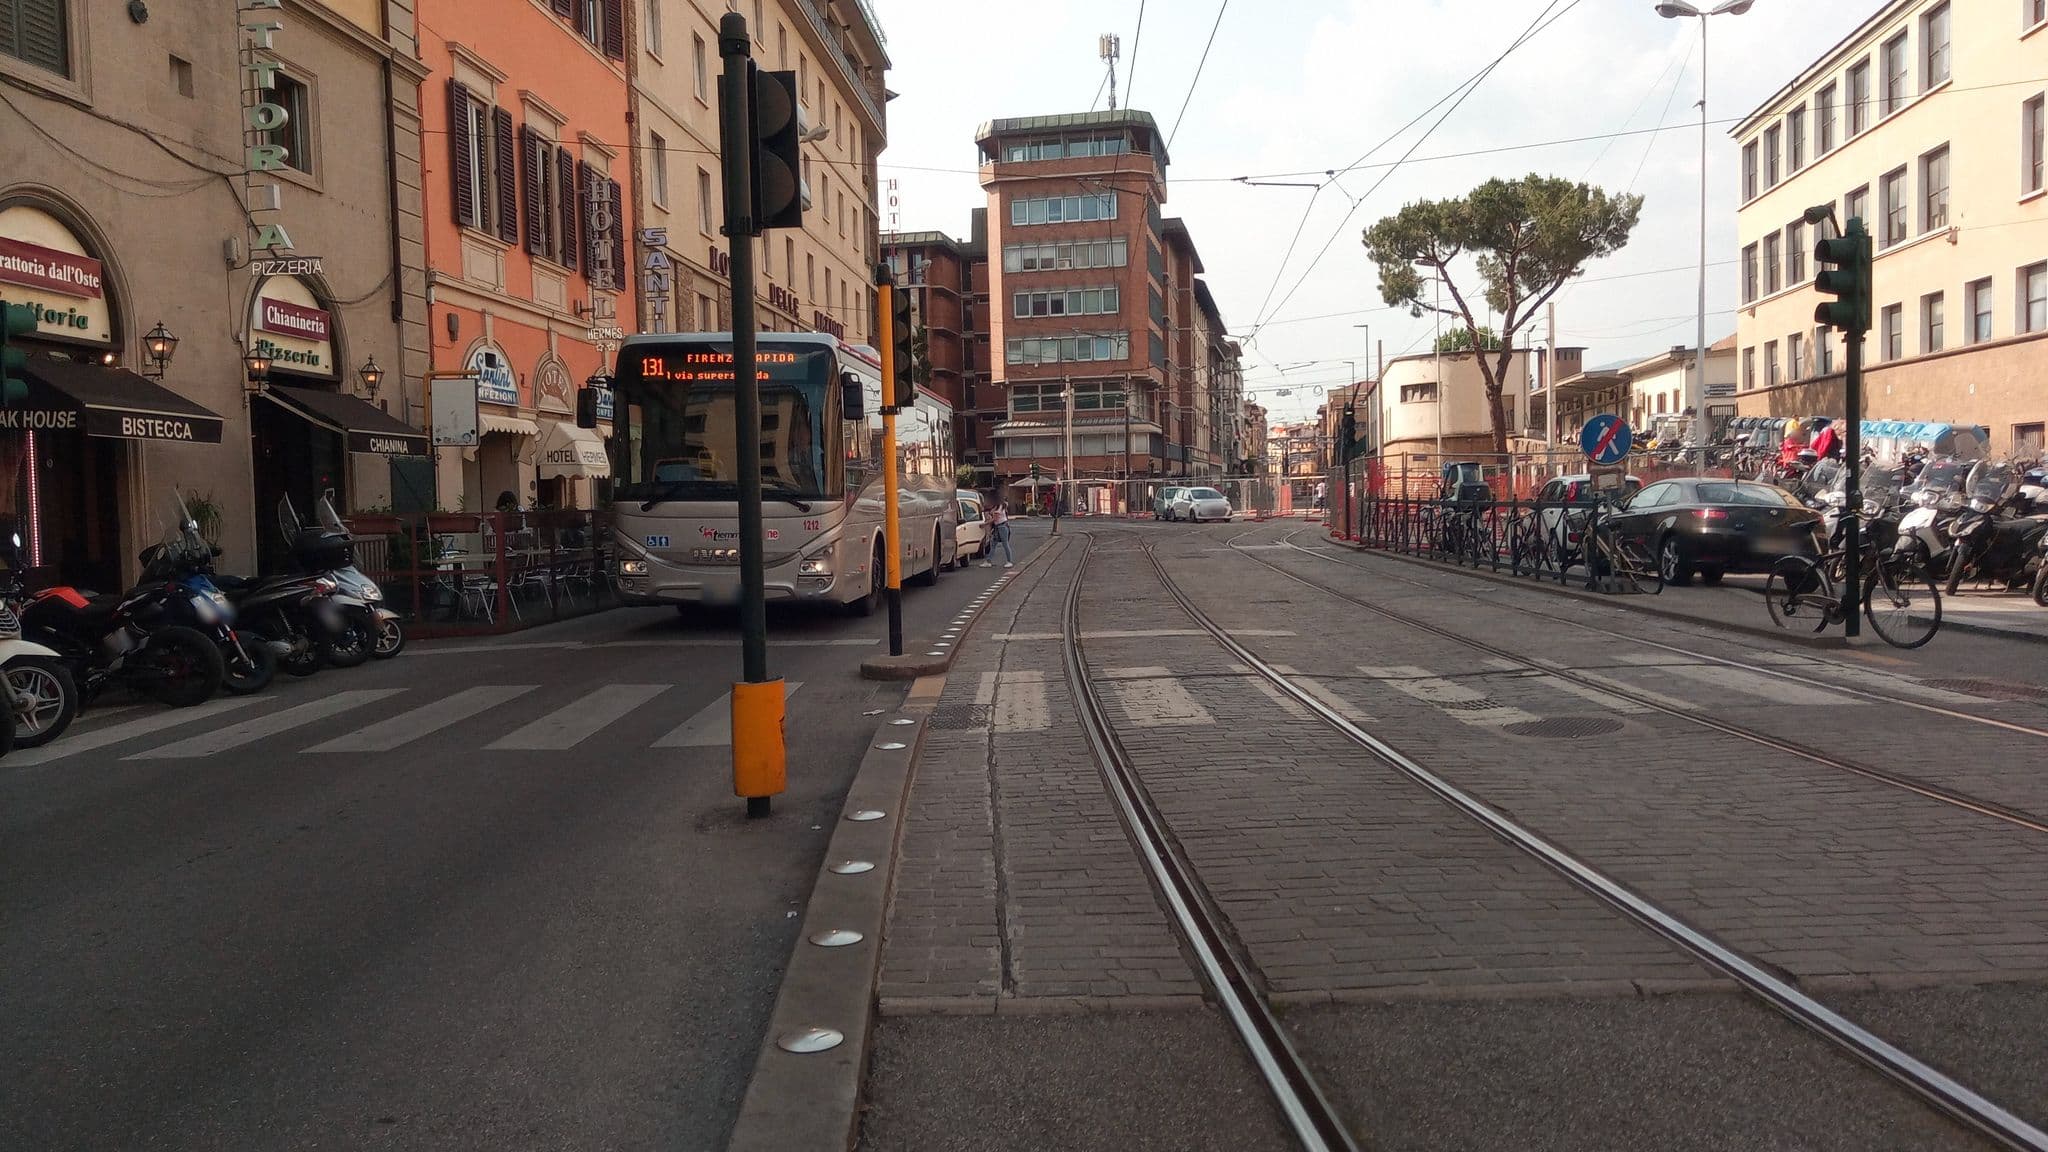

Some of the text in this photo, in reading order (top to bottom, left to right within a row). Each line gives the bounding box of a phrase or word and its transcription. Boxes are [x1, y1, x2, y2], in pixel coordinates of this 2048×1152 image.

[591, 179, 616, 320] HOTEL
[48, 262, 100, 288] dall'Oste
[252, 259, 324, 276] PIZZERIA
[267, 305, 325, 334] Chianineria
[587, 327, 623, 340] HERMES
[259, 339, 320, 366] Pizzeria
[687, 353, 794, 363] FIRENZ APIDA
[642, 358, 664, 376] 131
[674, 371, 694, 380] via
[478, 388, 517, 403] NFEZIONI
[23, 410, 77, 429] HOUSE
[122, 417, 193, 440] BISTECCA
[370, 438, 409, 454] CHIANINA
[547, 450, 576, 463] HOTEL
[803, 520, 819, 530] 1212
